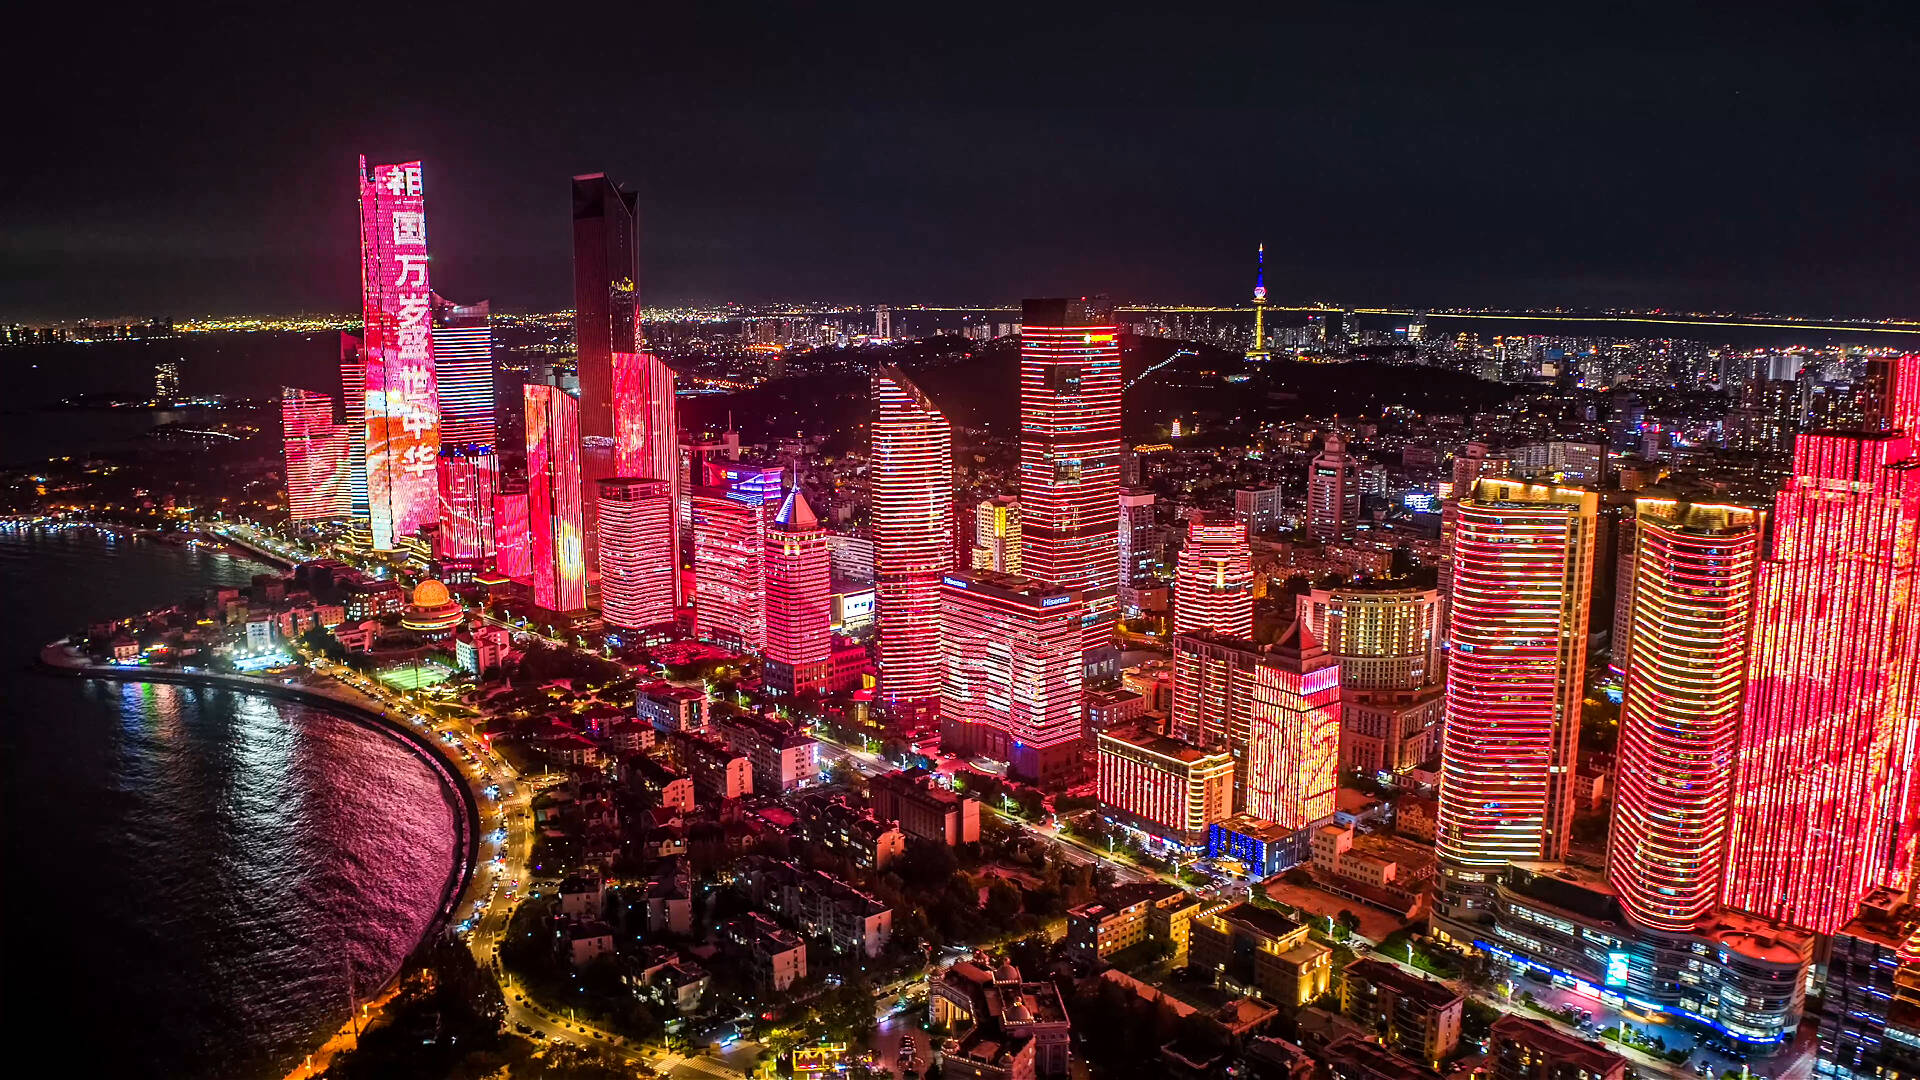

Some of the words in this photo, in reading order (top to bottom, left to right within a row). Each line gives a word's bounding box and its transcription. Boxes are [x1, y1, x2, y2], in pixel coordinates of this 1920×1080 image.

[386, 164, 437, 478] 祖国万岁盛世中华
[1042, 596, 1070, 607] Hisense
